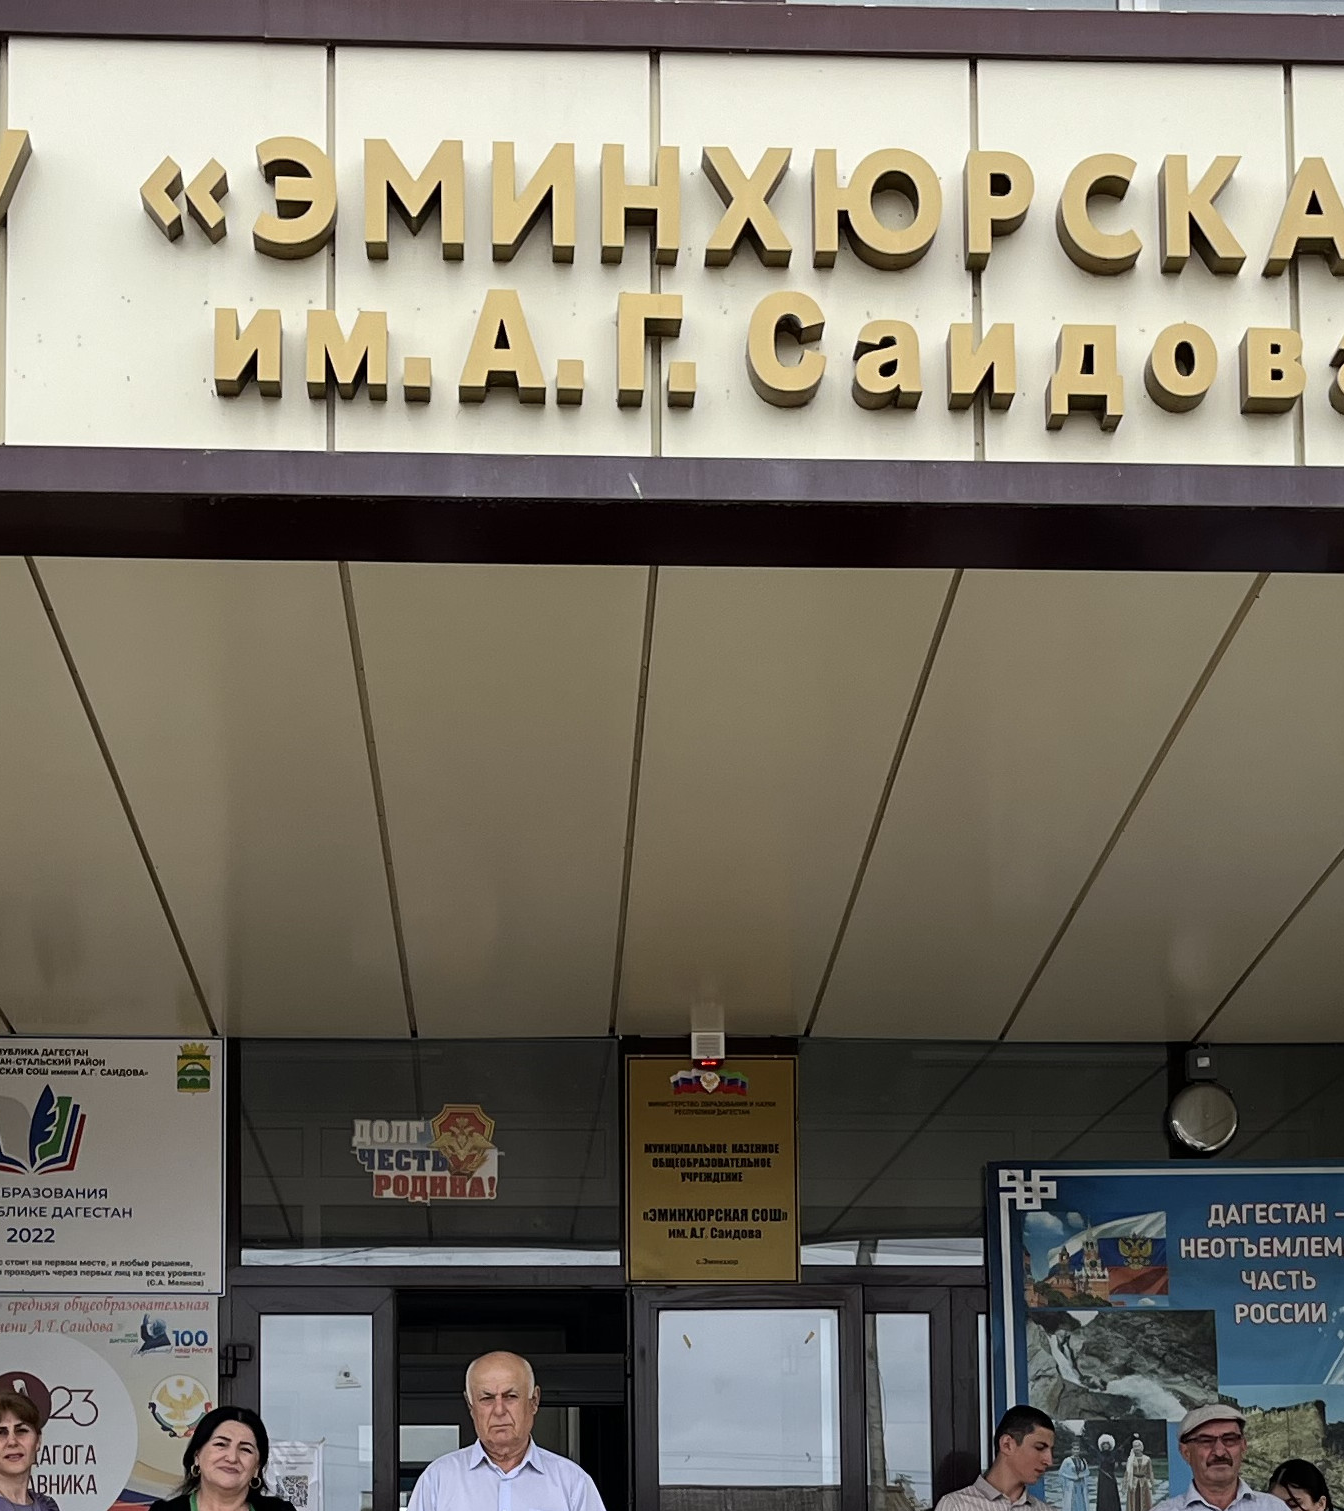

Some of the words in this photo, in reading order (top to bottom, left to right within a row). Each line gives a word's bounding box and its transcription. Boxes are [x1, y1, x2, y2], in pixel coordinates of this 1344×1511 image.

[41, 1048, 89, 1057] ДАГЕСТАН
[74, 1058, 105, 1066] РАЙОН
[26, 1067, 49, 1075] СОШ
[352, 1120, 424, 1147] ДОЛГ
[644, 1144, 727, 1155] МУНИЦИПАЛЬНОЕ
[358, 1149, 448, 1172] ЧЕСТЬ
[652, 1158, 772, 1169] ОБЩЕОБРАЗОВАТЕЛЬНОЕ
[681, 1172, 743, 1183] УЧРЕЖДЕНИЕ
[375, 1175, 496, 1200] РОДИНА!
[51, 1207, 133, 1219] ДАГЕСТАН
[643, 1208, 748, 1222] «ЭМИНХЮРСКАЯ
[751, 1208, 787, 1222] СОШ»
[1207, 1203, 1325, 1228] ДАГЕСТАН
[6, 1228, 55, 1243] 2022
[710, 1227, 761, 1240] Саидова
[1241, 1270, 1316, 1290] ЧАСТЬ
[7, 1298, 59, 1316] средняя
[64, 1296, 209, 1315] общеобразовательная
[1235, 1302, 1327, 1324] РОССИИ
[172, 1330, 208, 1347] 100
